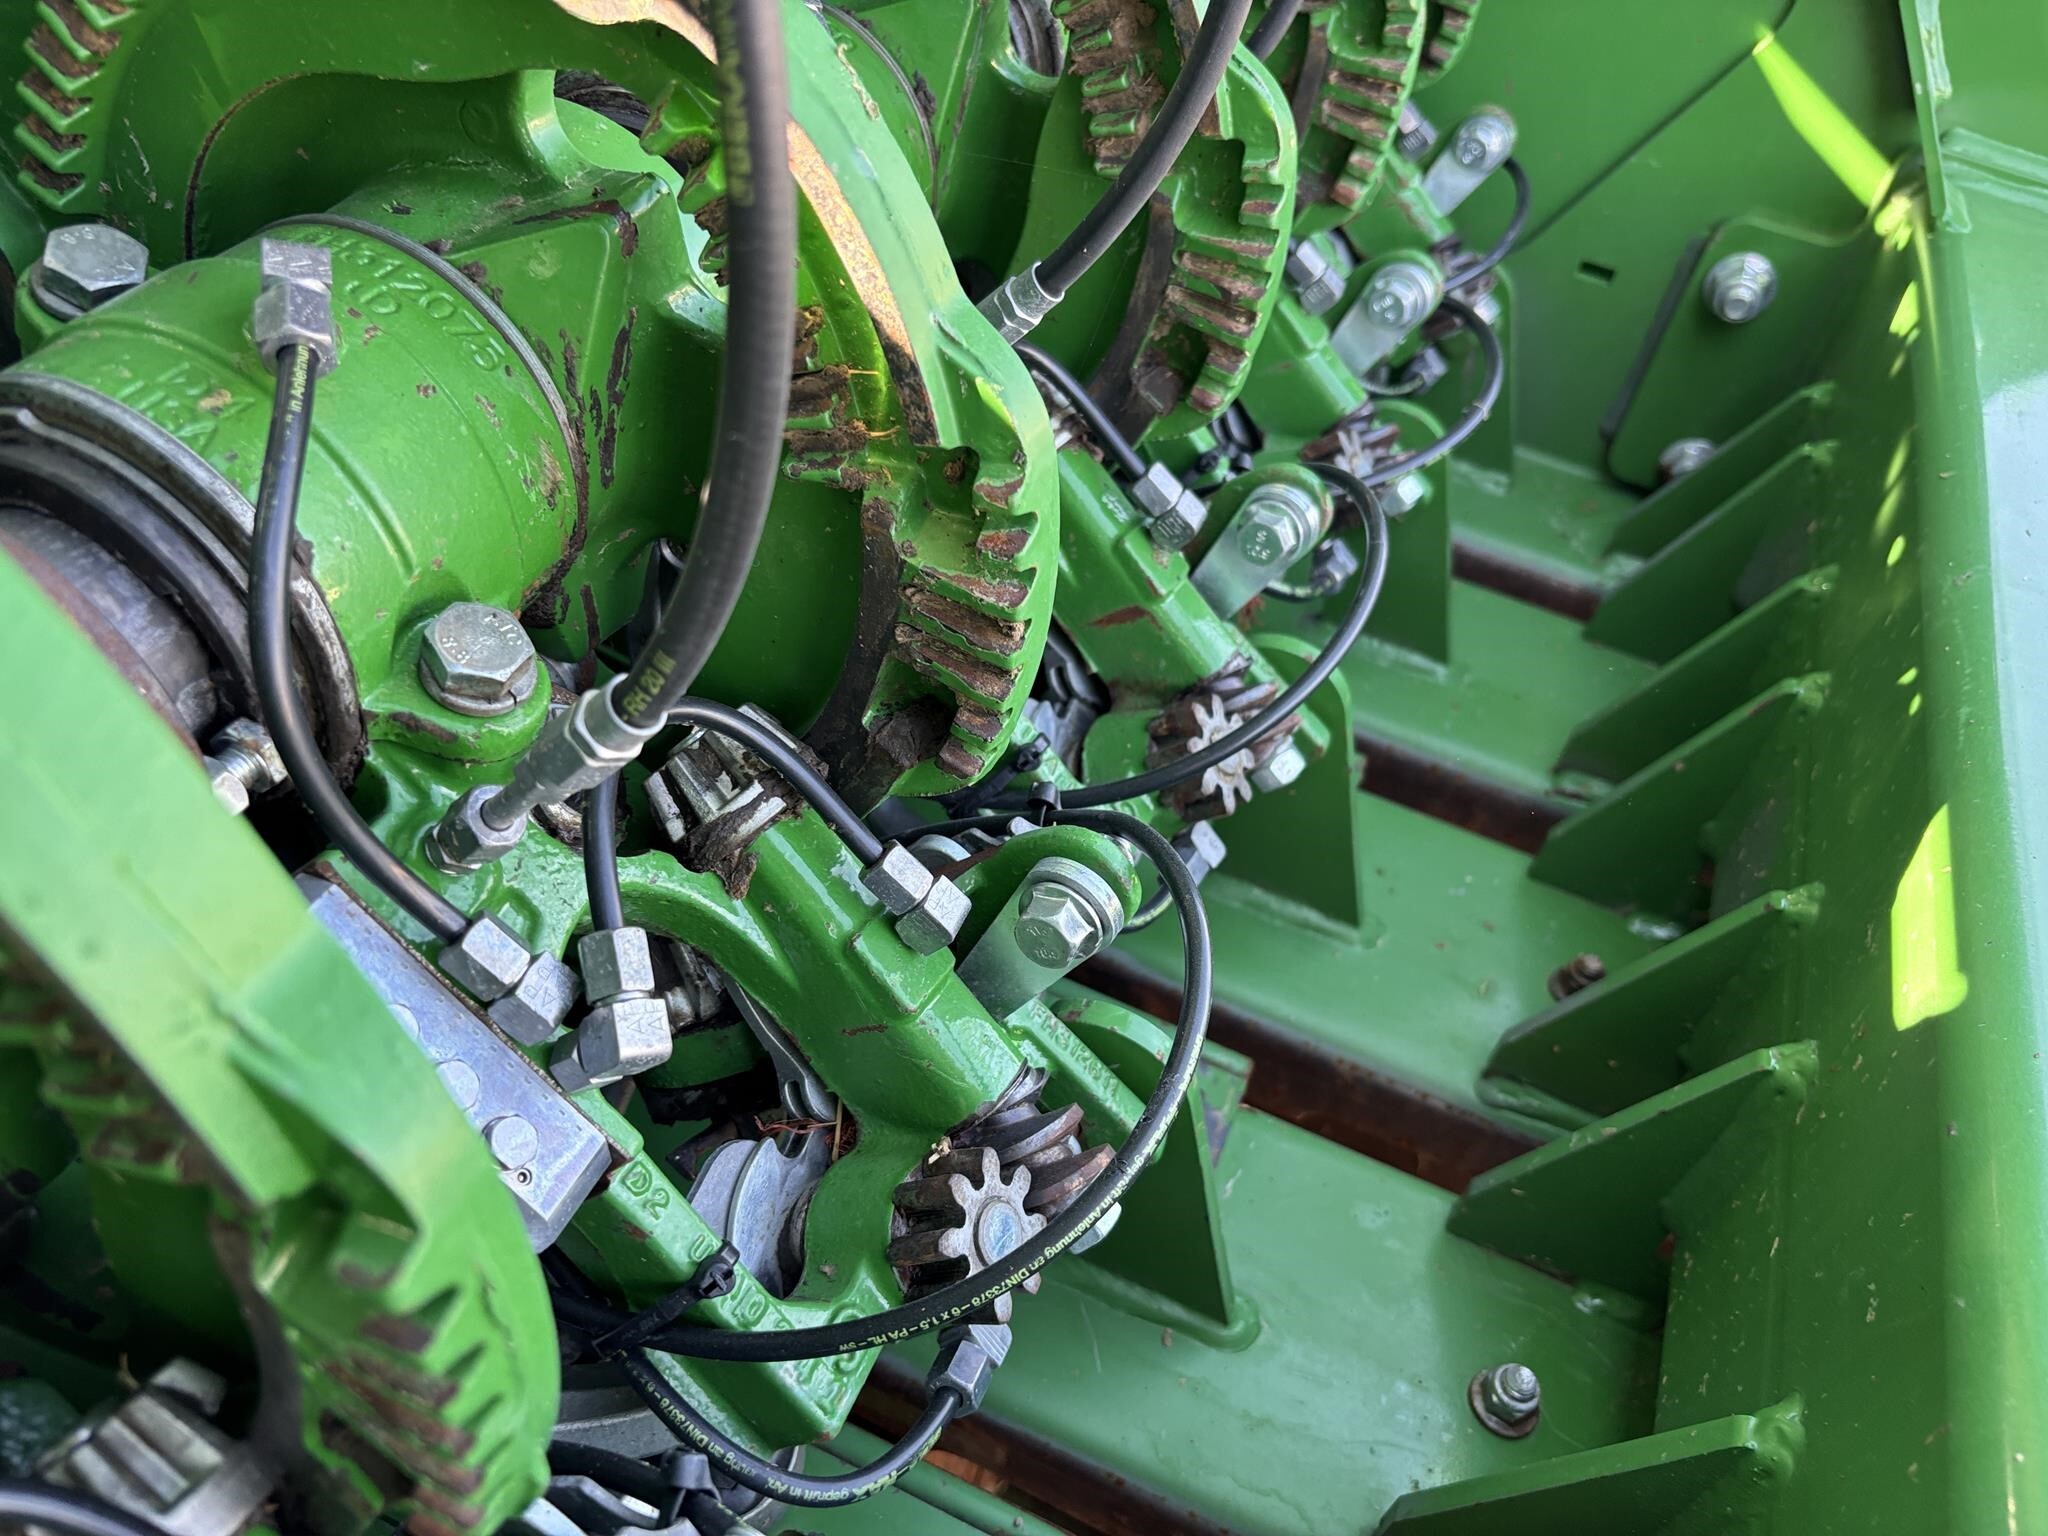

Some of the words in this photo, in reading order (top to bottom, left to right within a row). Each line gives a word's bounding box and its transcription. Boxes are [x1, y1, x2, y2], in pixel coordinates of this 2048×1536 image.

[622, 1160, 671, 1222] D2
[1101, 1195, 1115, 1209] in
[1044, 1206, 1102, 1260] Anlehnung
[707, 1442, 725, 1458] an
[789, 1485, 802, 1499] in
